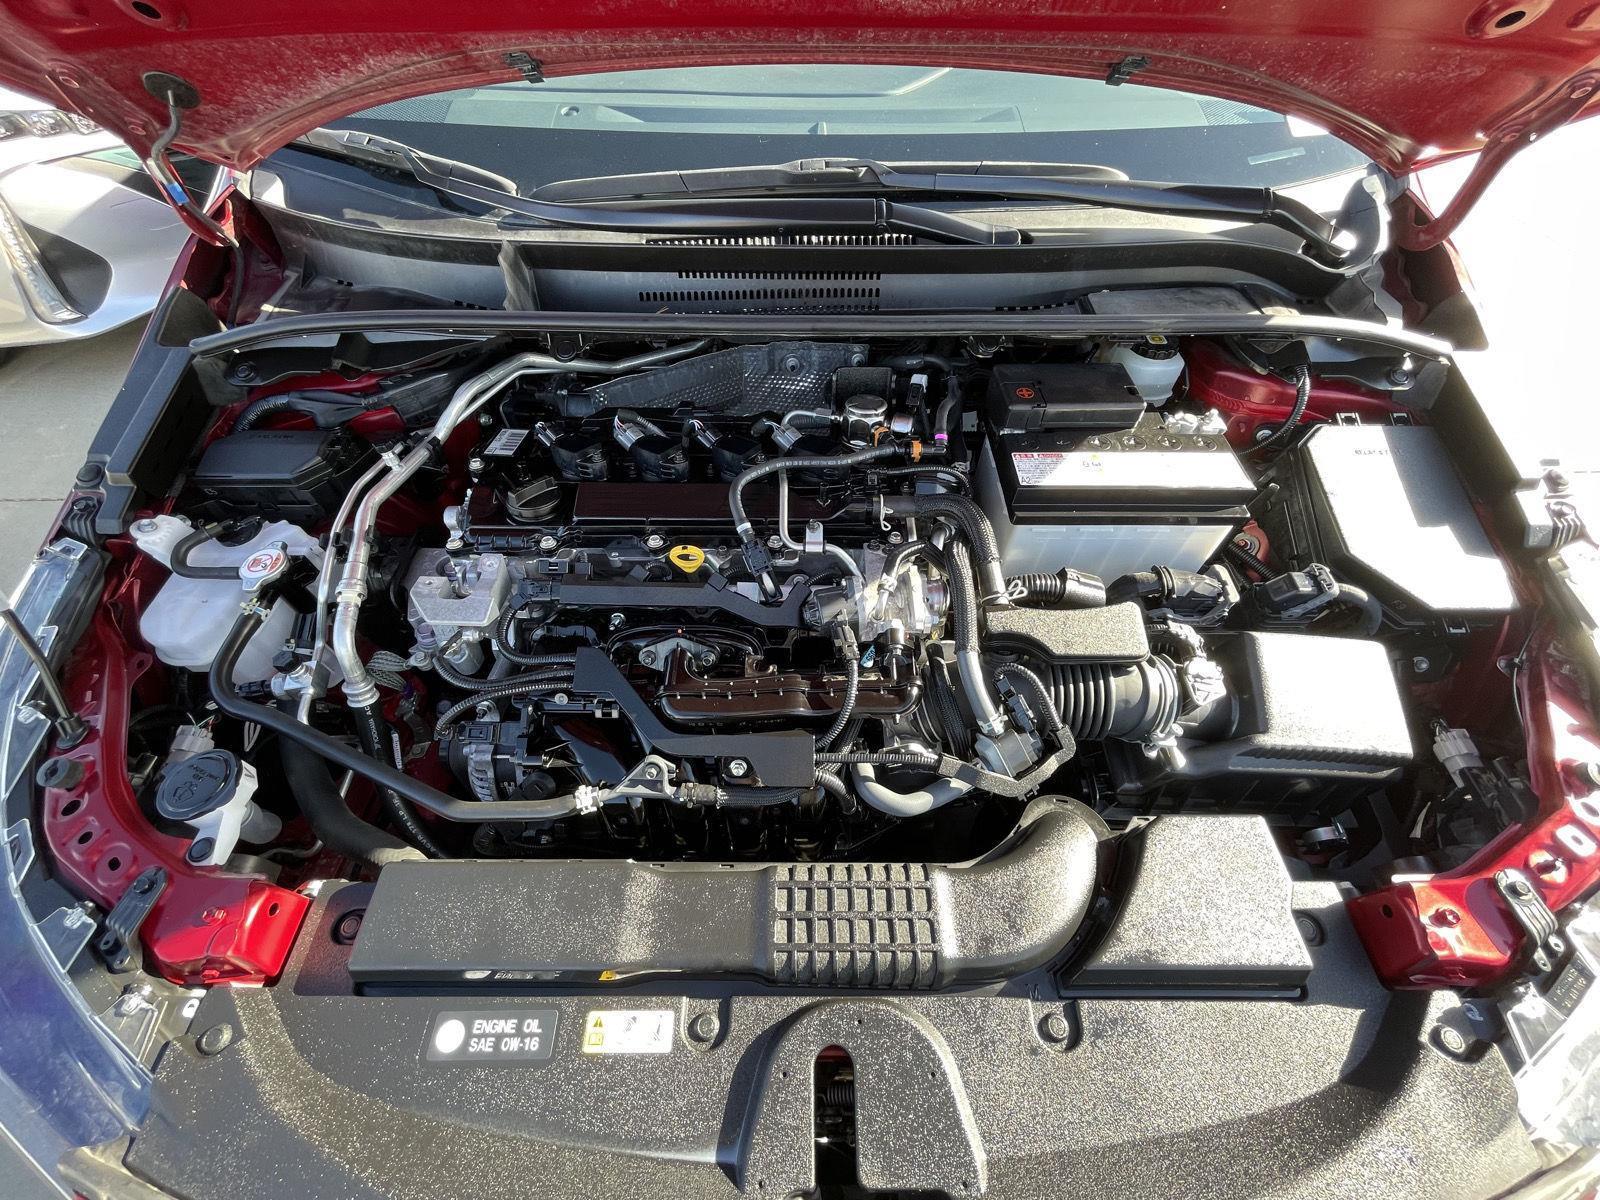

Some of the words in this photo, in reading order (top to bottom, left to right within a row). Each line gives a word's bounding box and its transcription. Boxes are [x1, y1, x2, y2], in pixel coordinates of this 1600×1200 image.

[473, 1019, 517, 1034] ENGINE
[523, 1018, 542, 1033] OIL
[468, 1036, 496, 1053] SAE
[500, 1036, 540, 1052] 0W-16
